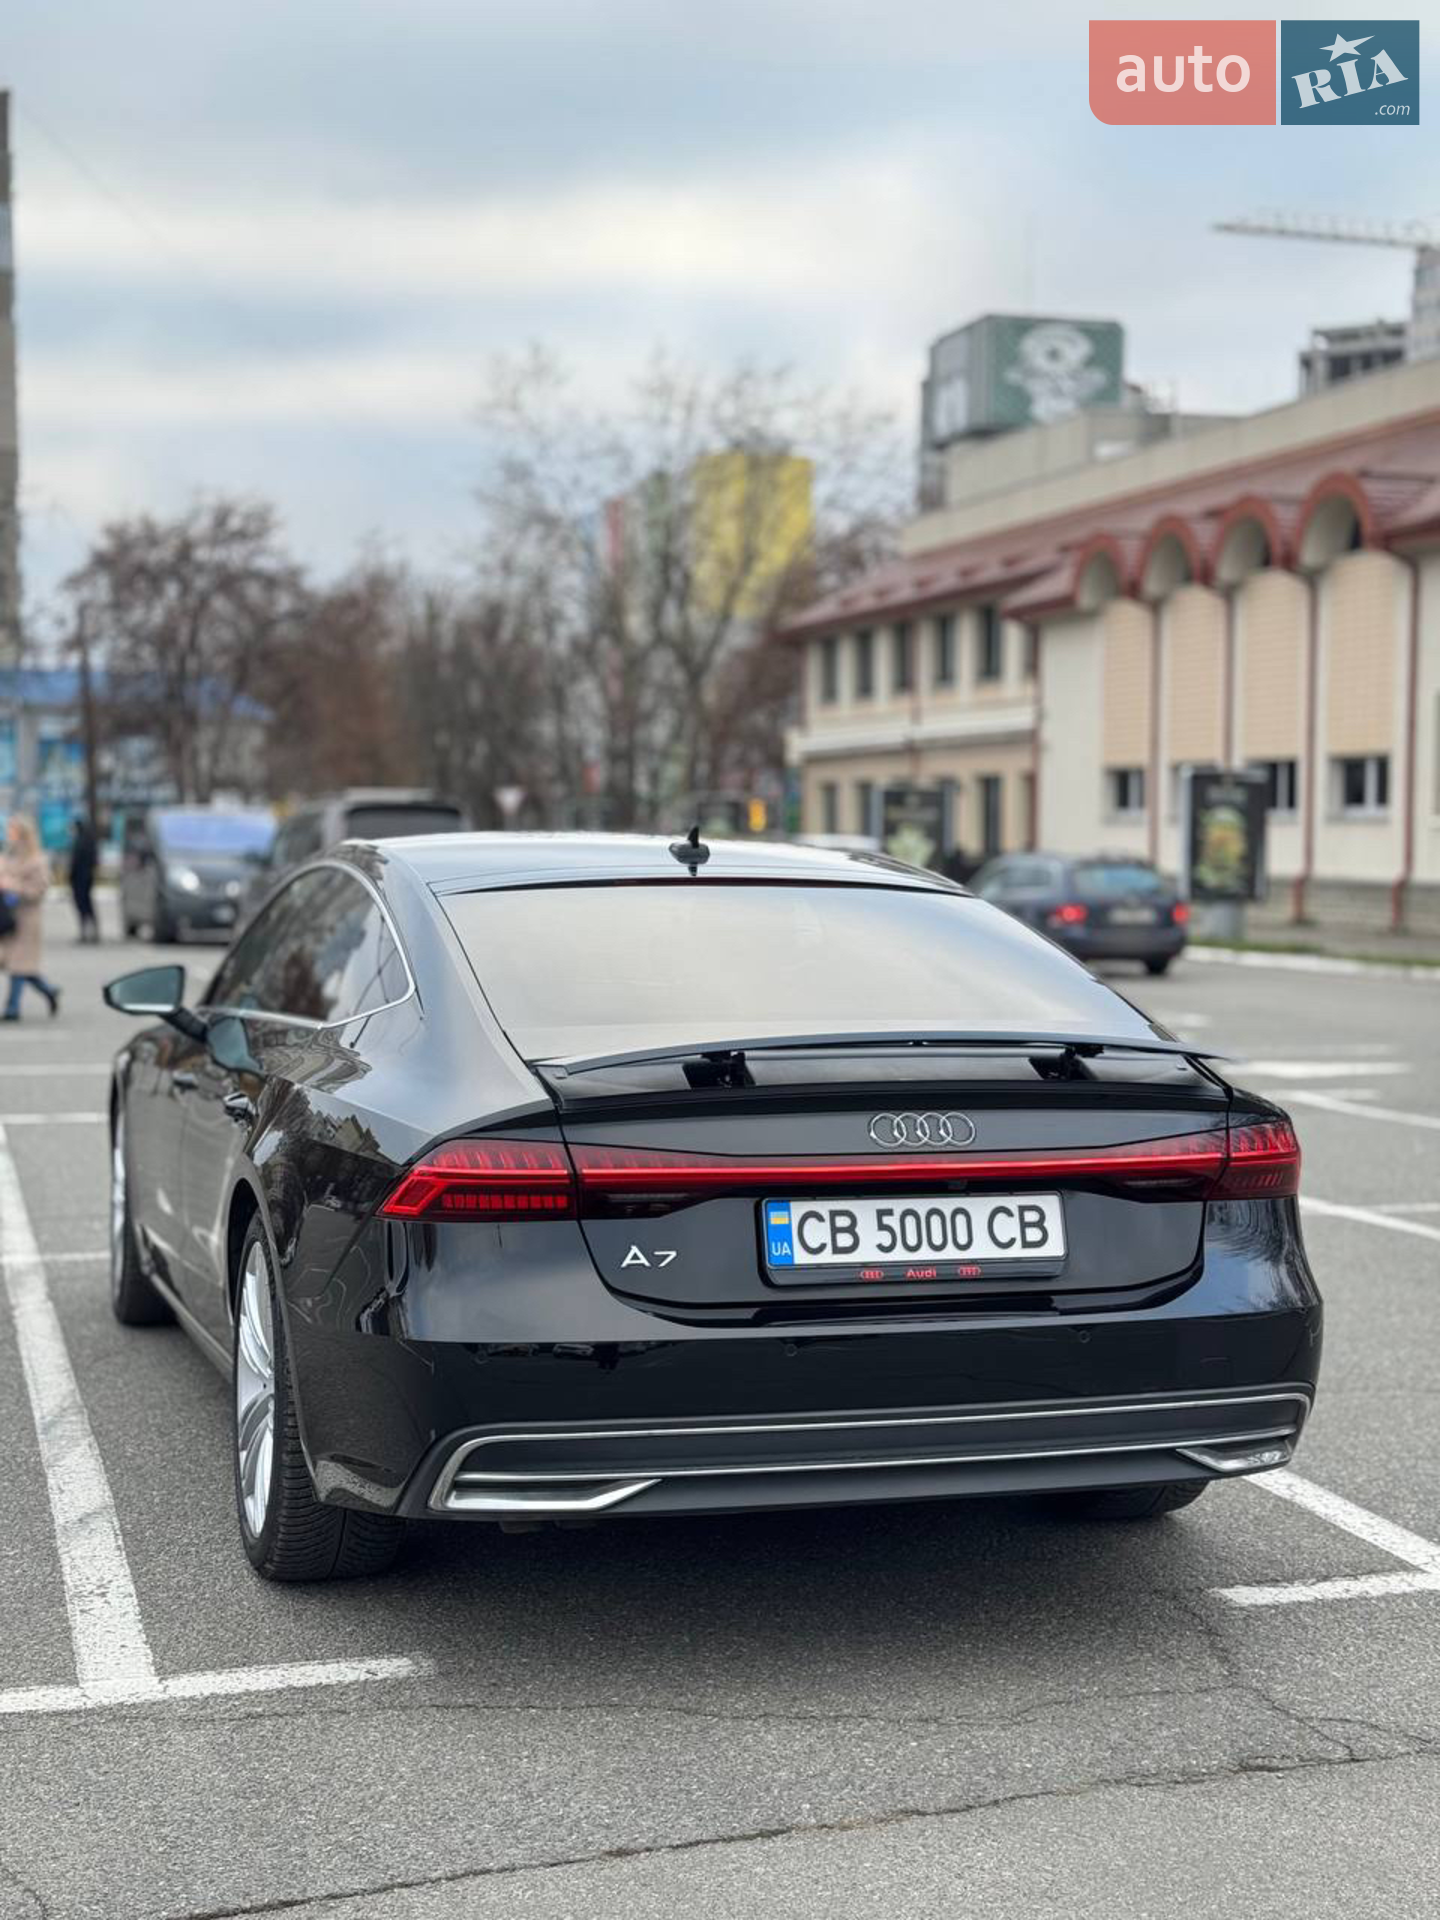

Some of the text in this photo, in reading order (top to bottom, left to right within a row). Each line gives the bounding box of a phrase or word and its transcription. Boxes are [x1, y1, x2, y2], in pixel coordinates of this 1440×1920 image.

[797, 1204, 1049, 1255] CB 5000 CB
[620, 1245, 677, 1267] A7
[771, 1241, 792, 1257] UA
[906, 1267, 937, 1279] Audi
